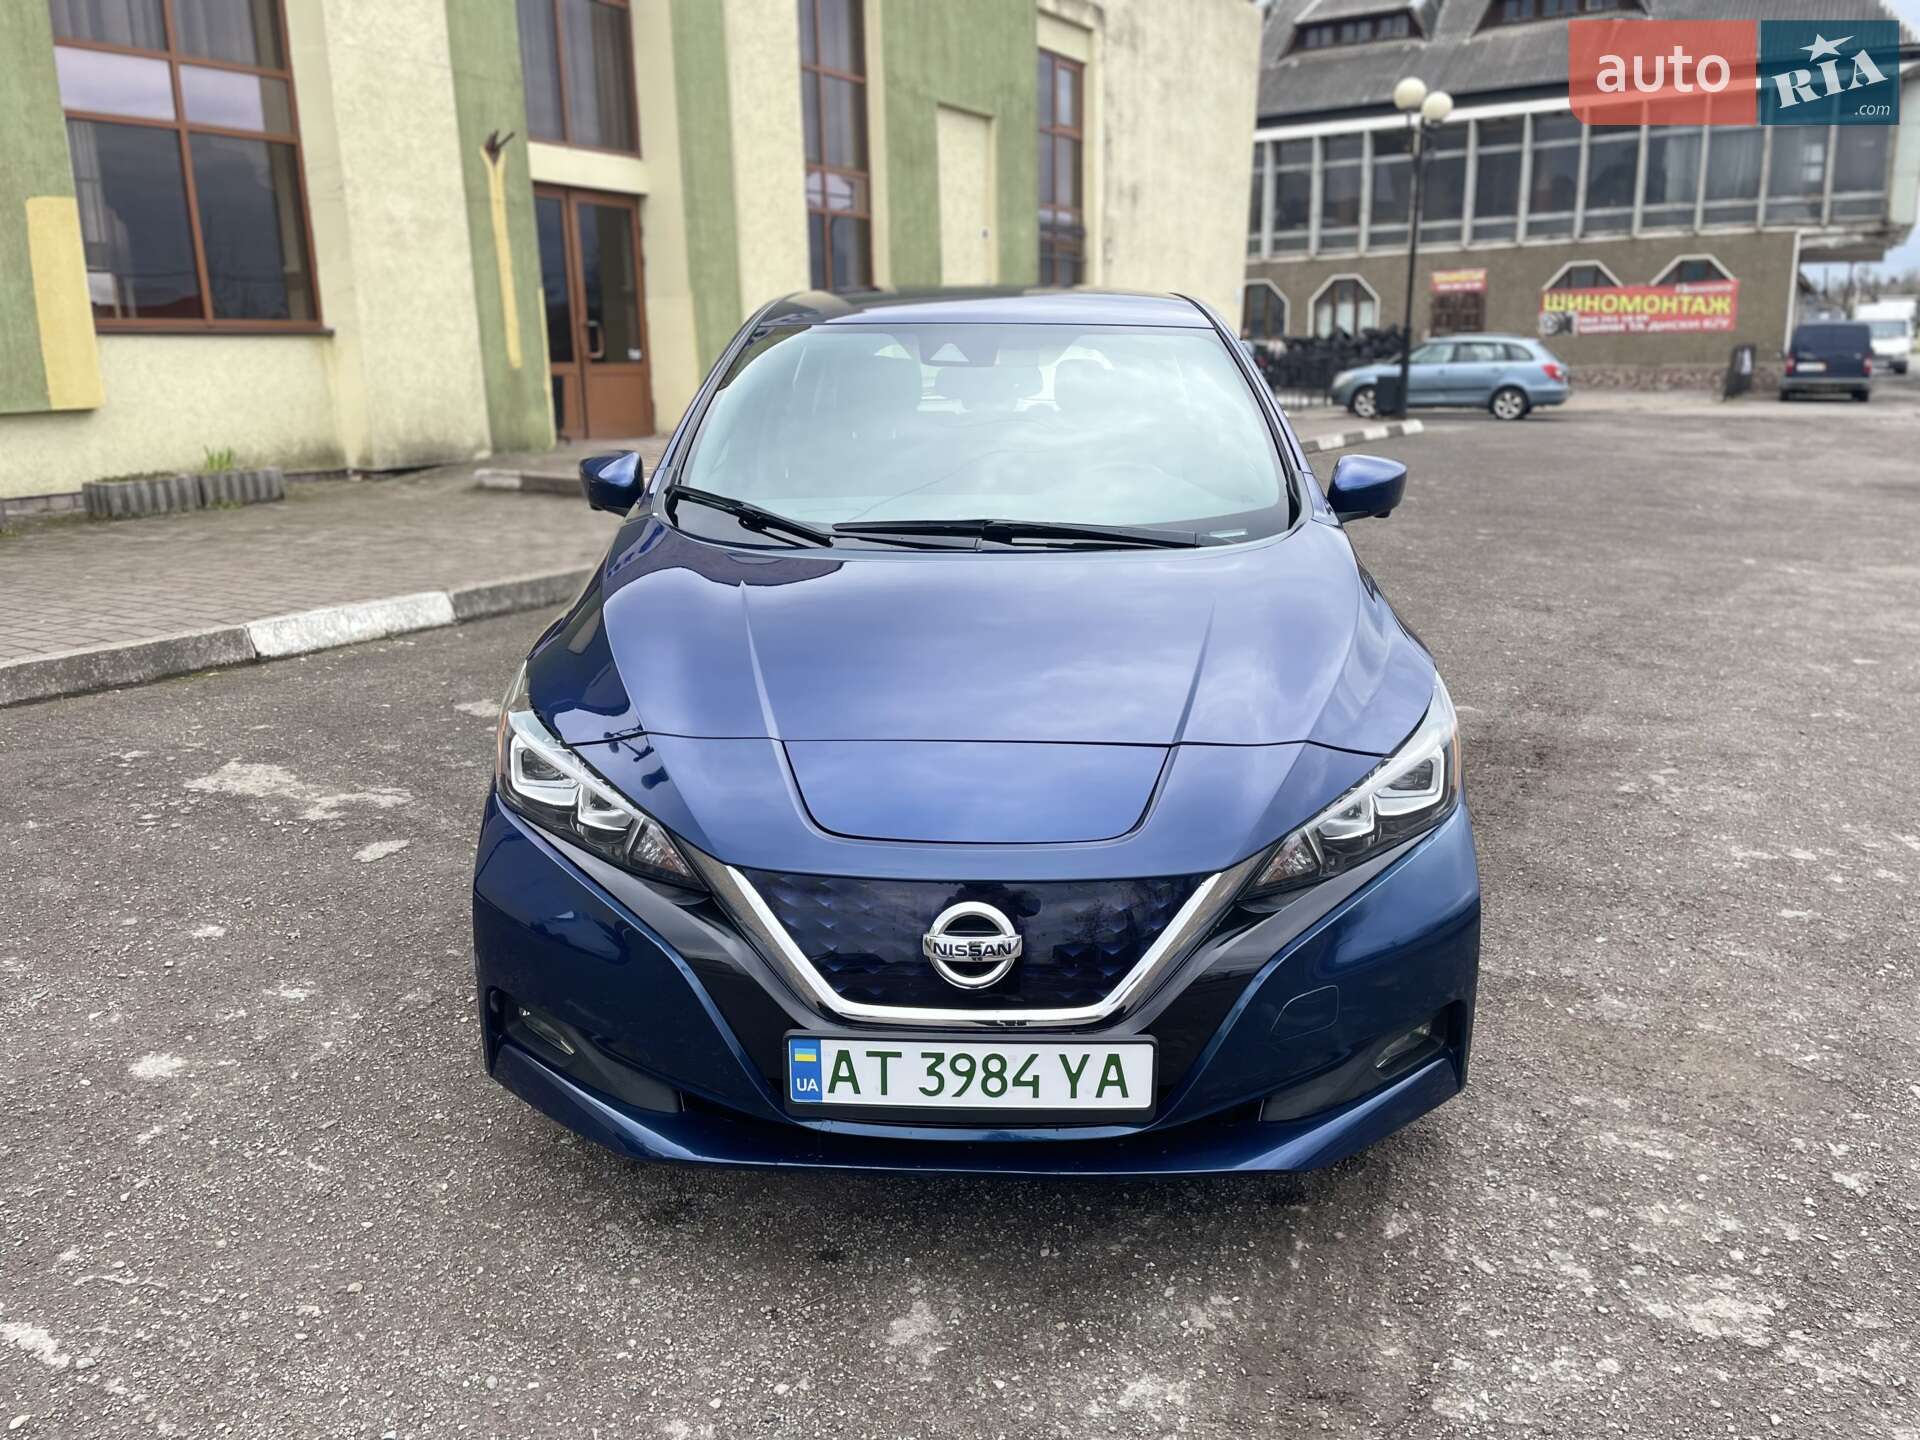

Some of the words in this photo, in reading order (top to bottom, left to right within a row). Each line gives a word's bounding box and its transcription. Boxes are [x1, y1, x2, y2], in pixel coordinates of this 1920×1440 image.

[1543, 292, 1731, 316] ШИНОМОНТАЖ
[932, 941, 1013, 957] NISSAN
[827, 1049, 903, 1096] AT
[918, 1051, 1040, 1099] 3984
[1058, 1053, 1130, 1099] YA
[796, 1078, 819, 1093] UA
